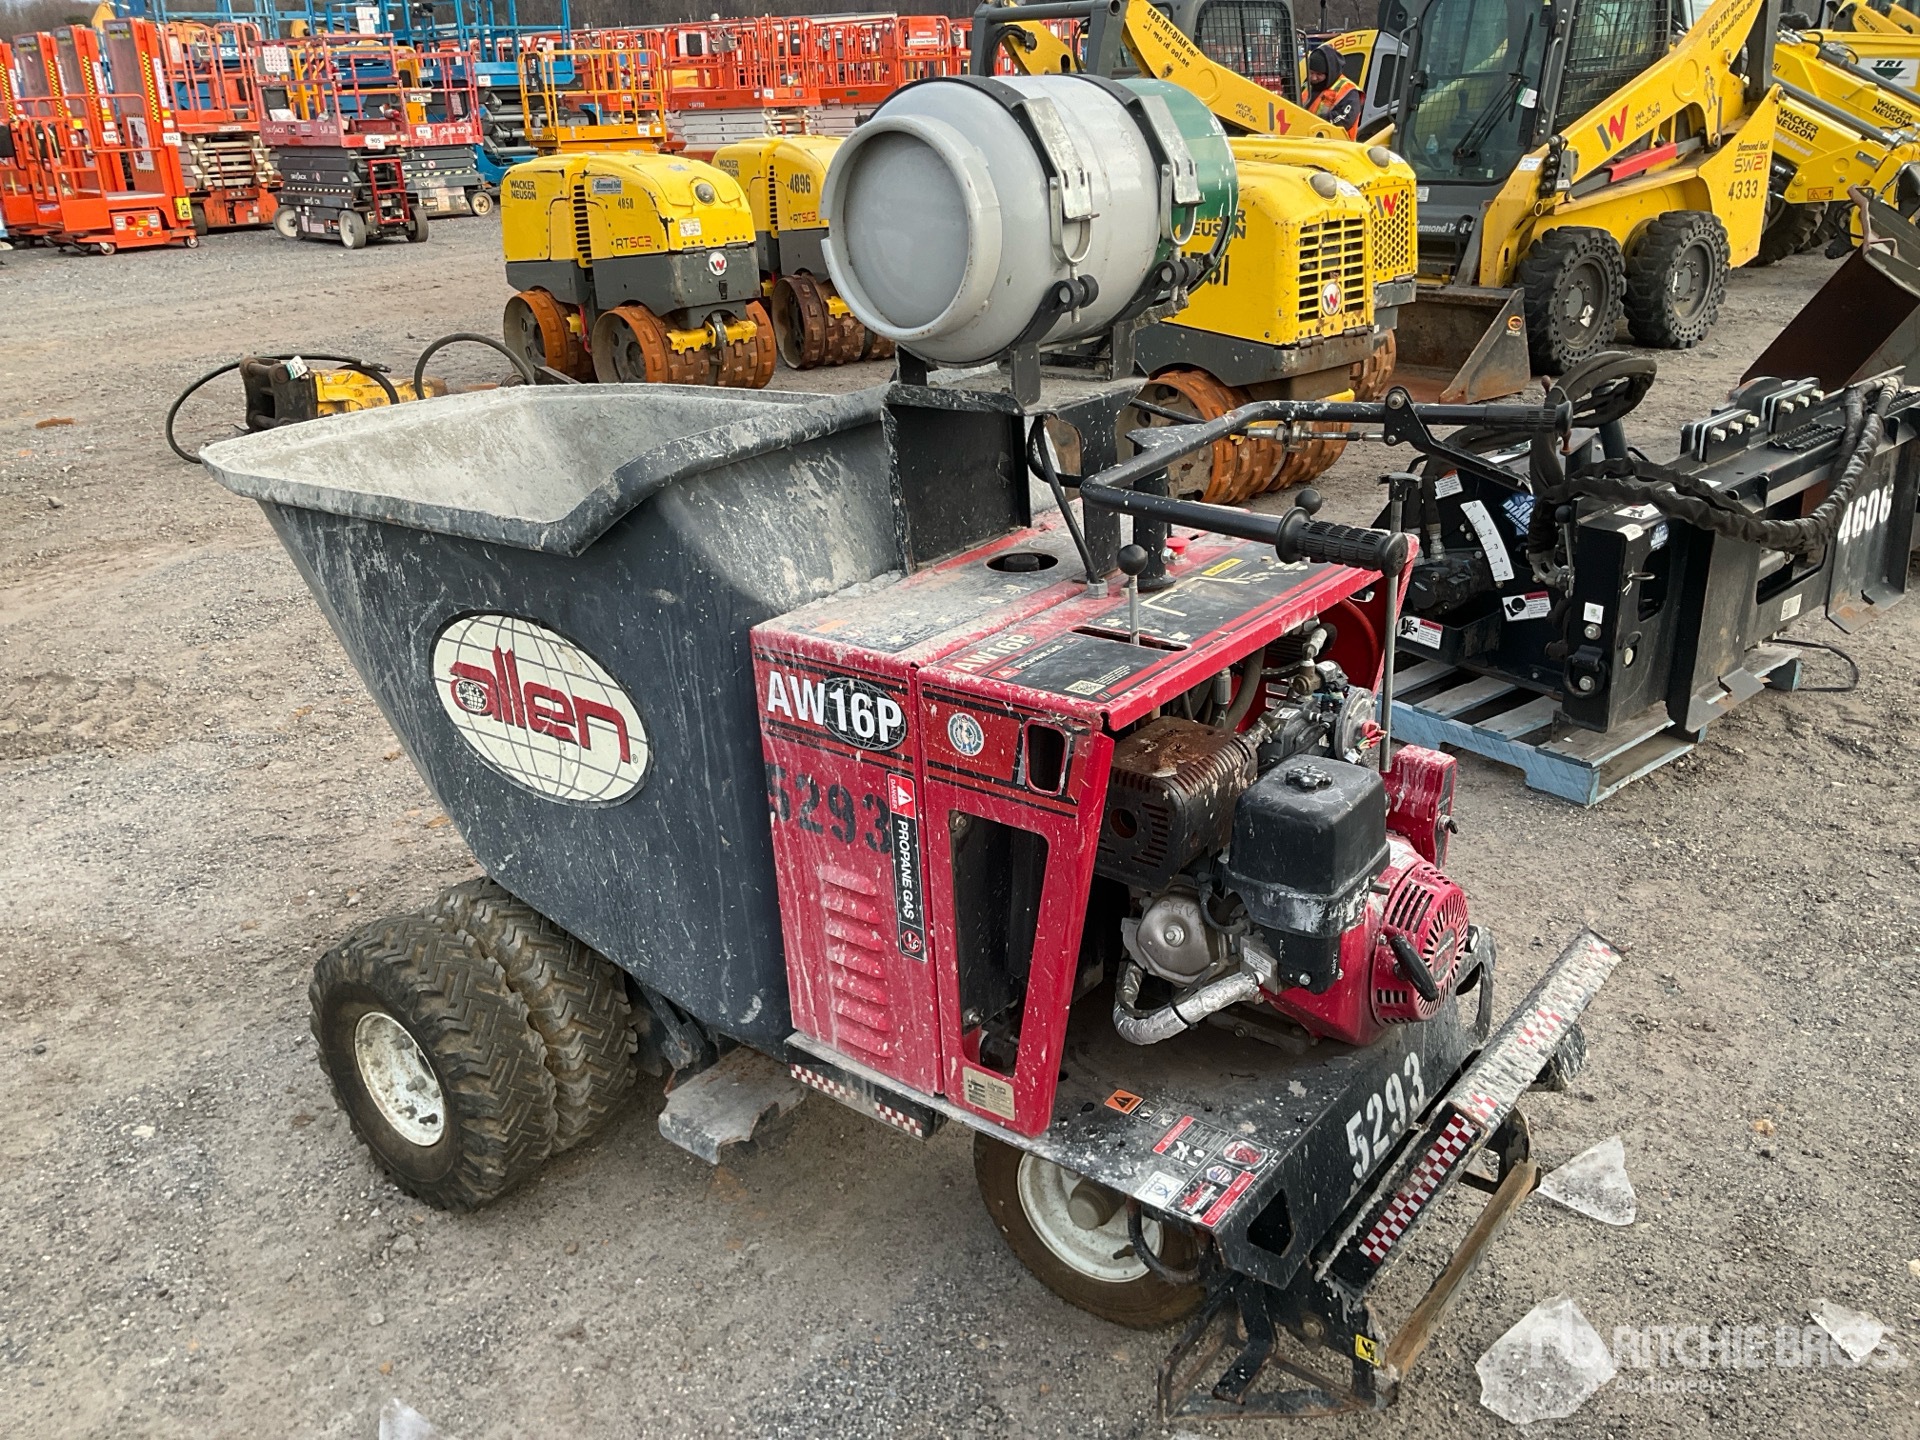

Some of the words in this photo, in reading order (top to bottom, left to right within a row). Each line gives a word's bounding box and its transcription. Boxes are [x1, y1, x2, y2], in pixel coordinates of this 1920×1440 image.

[1780, 107, 1819, 134] WACKER
[1875, 98, 1913, 121] WACKER
[719, 159, 739, 169] WACKER
[1733, 155, 1768, 174] SW21
[510, 180, 535, 191] WACKER
[511, 190, 536, 201] NEUSON
[790, 174, 811, 194] 4896
[1728, 179, 1758, 201] 4333
[615, 236, 652, 249] RTSC3
[1838, 484, 1894, 546] 4606
[952, 634, 1030, 673] AW16P
[450, 645, 632, 765] allen
[767, 670, 902, 743] AW16P
[889, 778, 898, 810] DANGER
[765, 763, 891, 854] 5293
[898, 819, 912, 889] PROPANE
[903, 890, 915, 920] GAS
[1345, 1051, 1425, 1179] 5293
